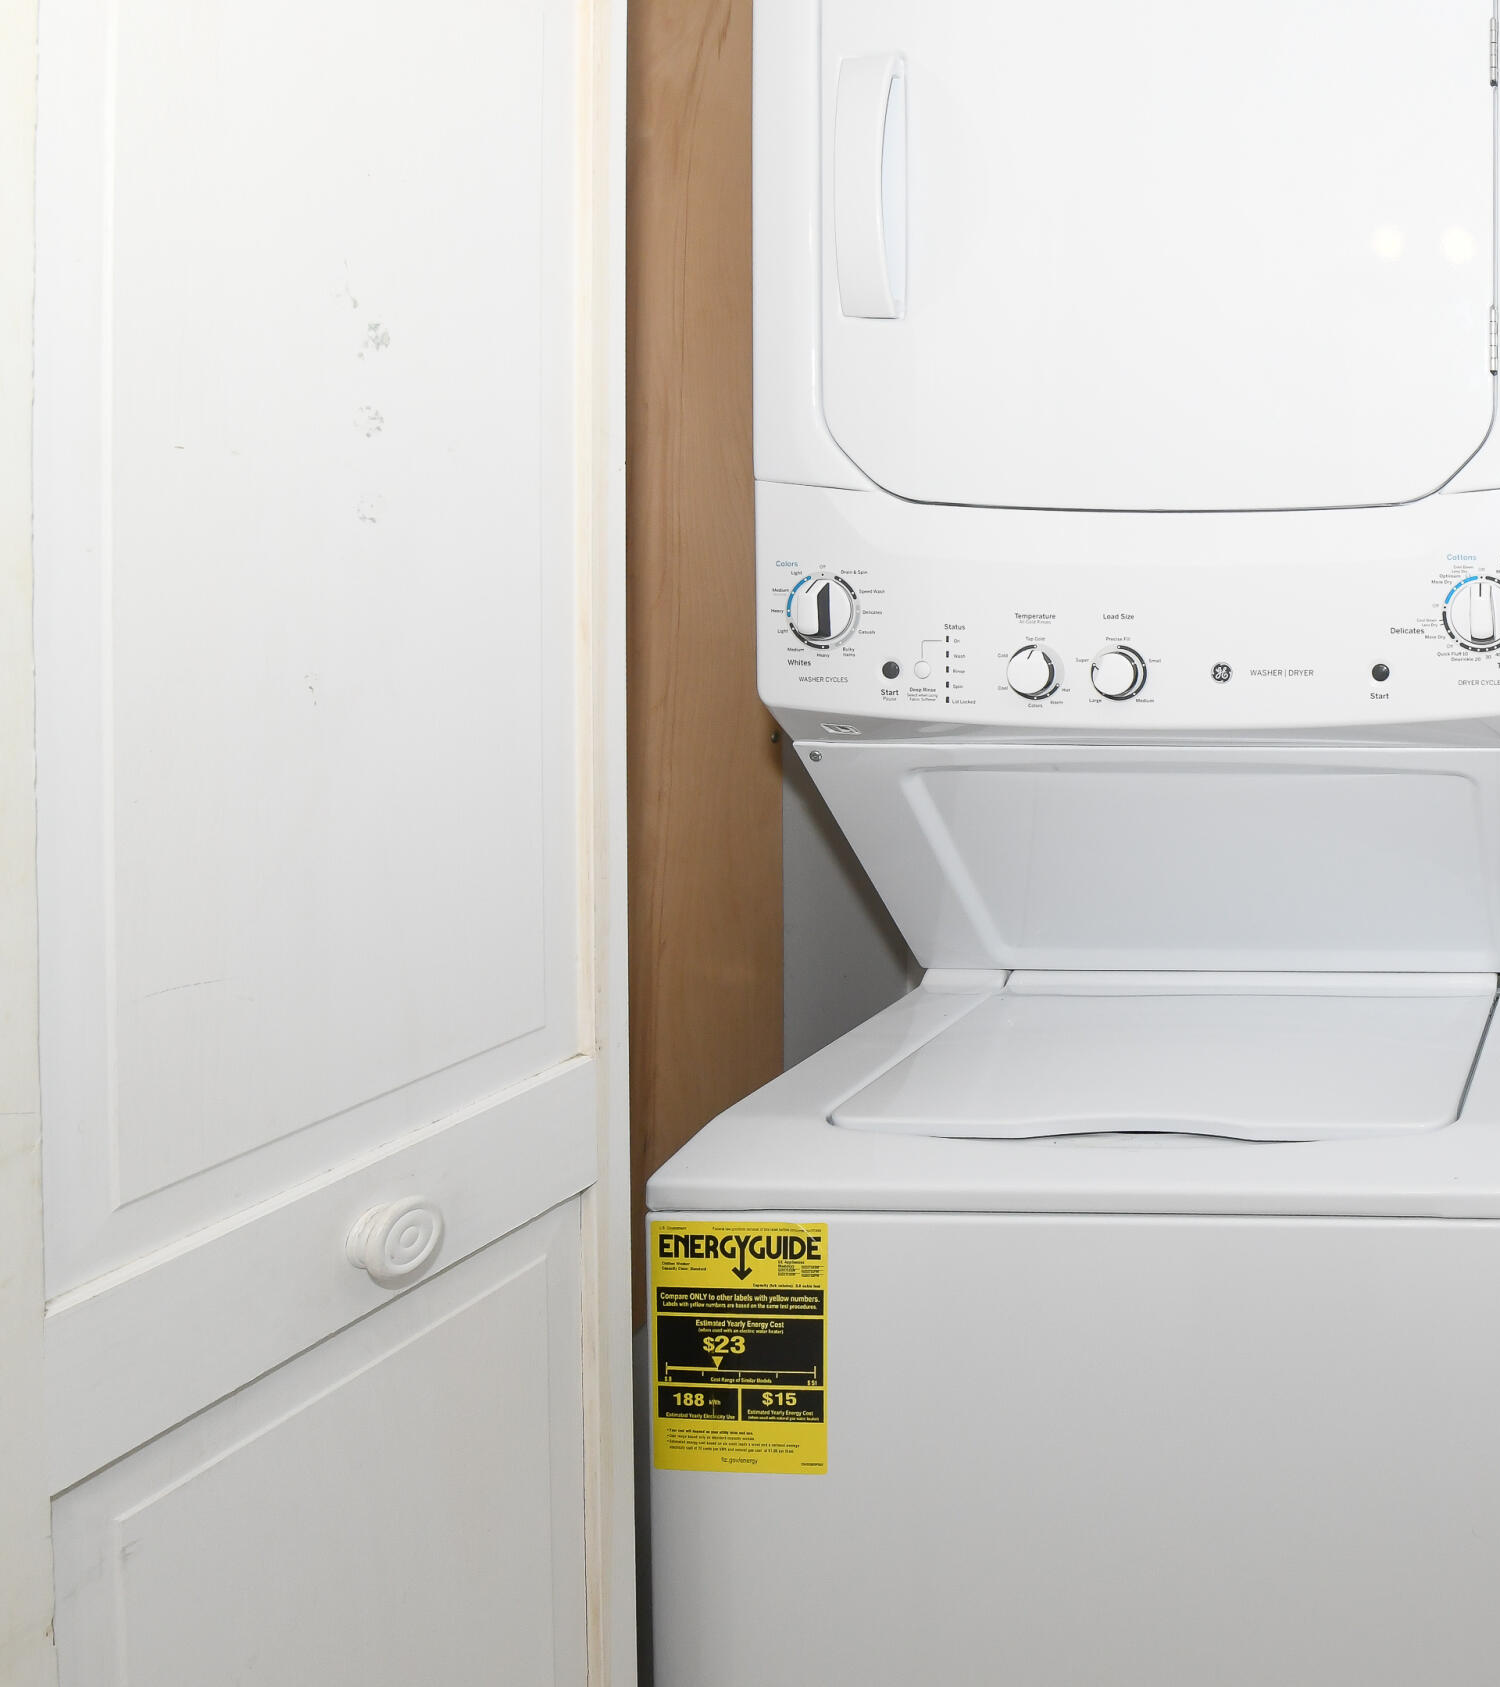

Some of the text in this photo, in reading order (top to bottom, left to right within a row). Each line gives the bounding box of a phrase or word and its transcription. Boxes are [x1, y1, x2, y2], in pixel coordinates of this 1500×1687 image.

[1015, 613, 1056, 621] Temperature
[1250, 669, 1314, 677] WASHER DRYER
[659, 1233, 821, 1260] ENERGYGUIDE
[660, 1291, 820, 1303] Compare ONLY to other labels with yellow numbers.
[696, 1320, 726, 1328] Estimated
[727, 1320, 746, 1329] Yearly
[747, 1321, 768, 1329] Energy
[703, 1335, 745, 1354] $23
[673, 1393, 704, 1406] 188
[762, 1392, 797, 1406] $15
